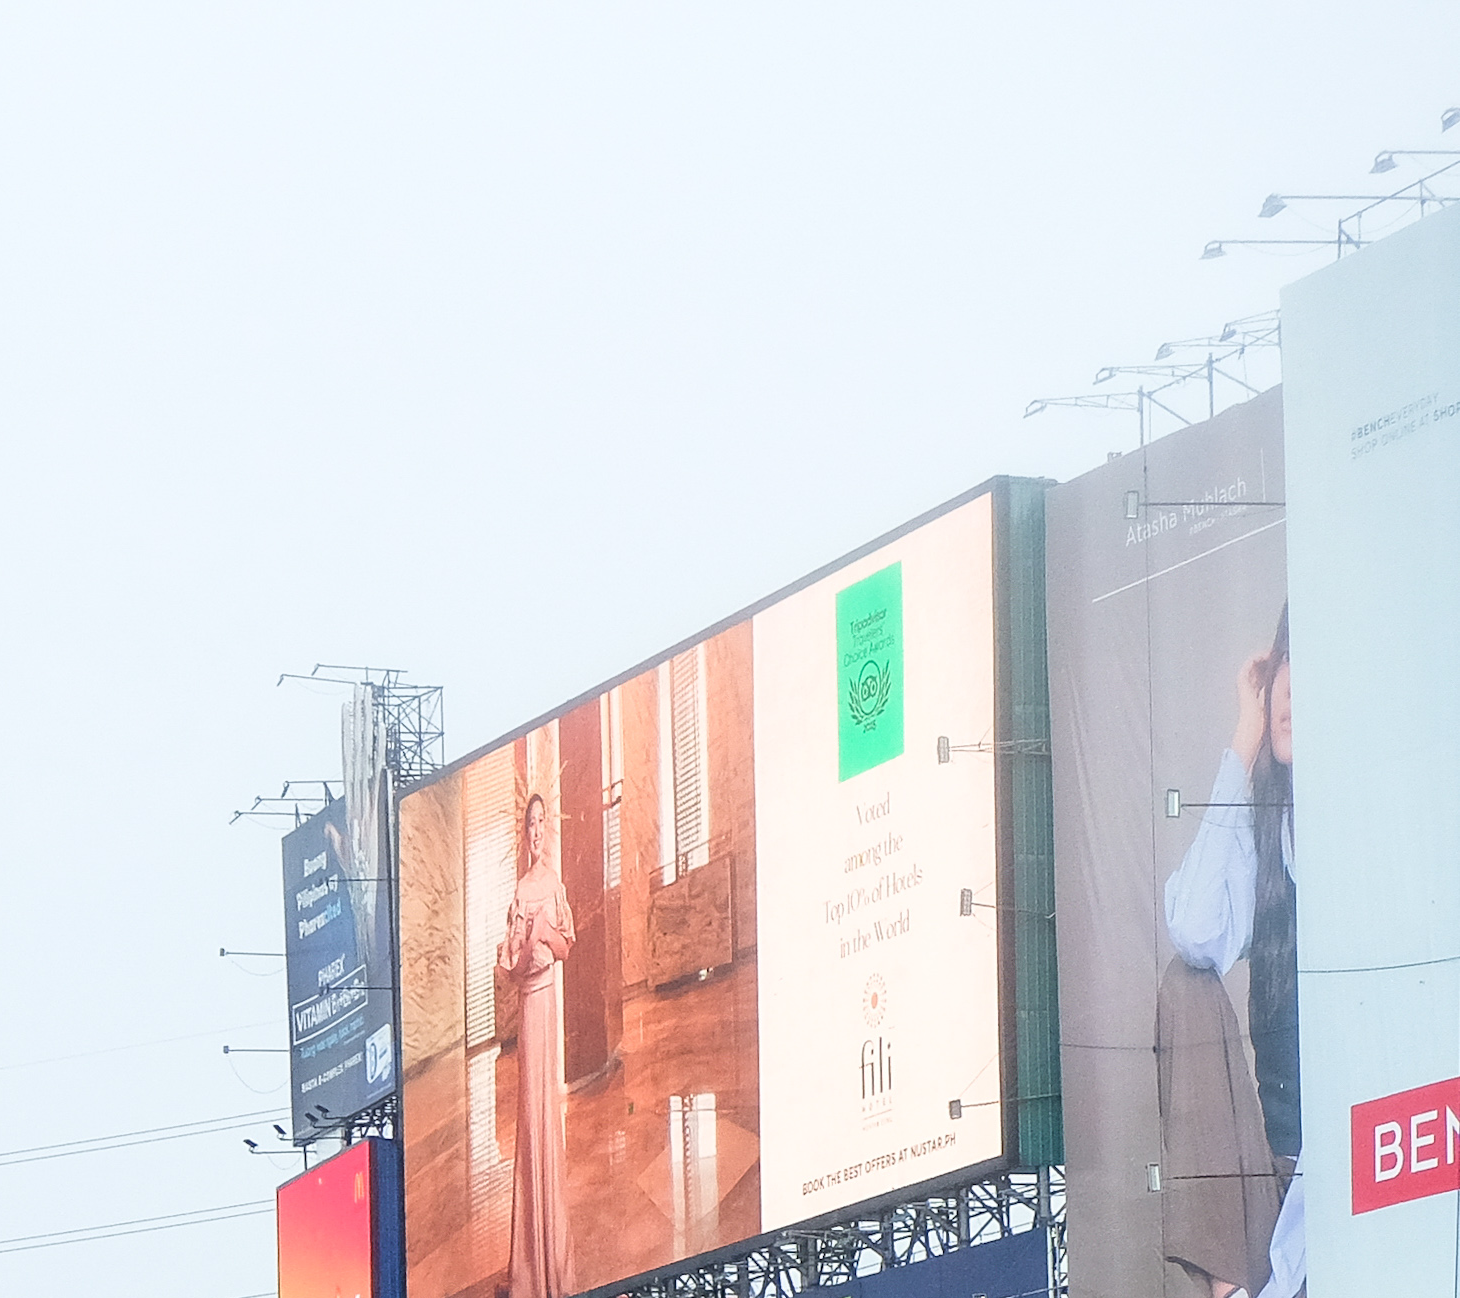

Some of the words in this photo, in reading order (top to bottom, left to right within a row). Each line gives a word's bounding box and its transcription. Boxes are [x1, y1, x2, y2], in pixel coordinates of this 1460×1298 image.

[1125, 511, 1178, 548] Atasha
[856, 791, 890, 826] Voted
[844, 842, 882, 873] among
[883, 832, 903, 856] the
[823, 900, 844, 926] Top
[847, 888, 870, 914] 10%
[872, 877, 884, 903] of
[886, 863, 923, 898] Hotels
[840, 938, 850, 959] in
[853, 929, 871, 954] the
[873, 908, 910, 943] World
[296, 996, 331, 1033] VITAMIN
[859, 1036, 892, 1099] fili
[802, 1175, 825, 1196] BOOK
[827, 1170, 842, 1187] THE
[843, 1163, 862, 1181] BEST
[865, 1152, 896, 1174] OFFERS
[898, 1147, 908, 1162] AT
[910, 1132, 957, 1160] NUSTAR.PH
